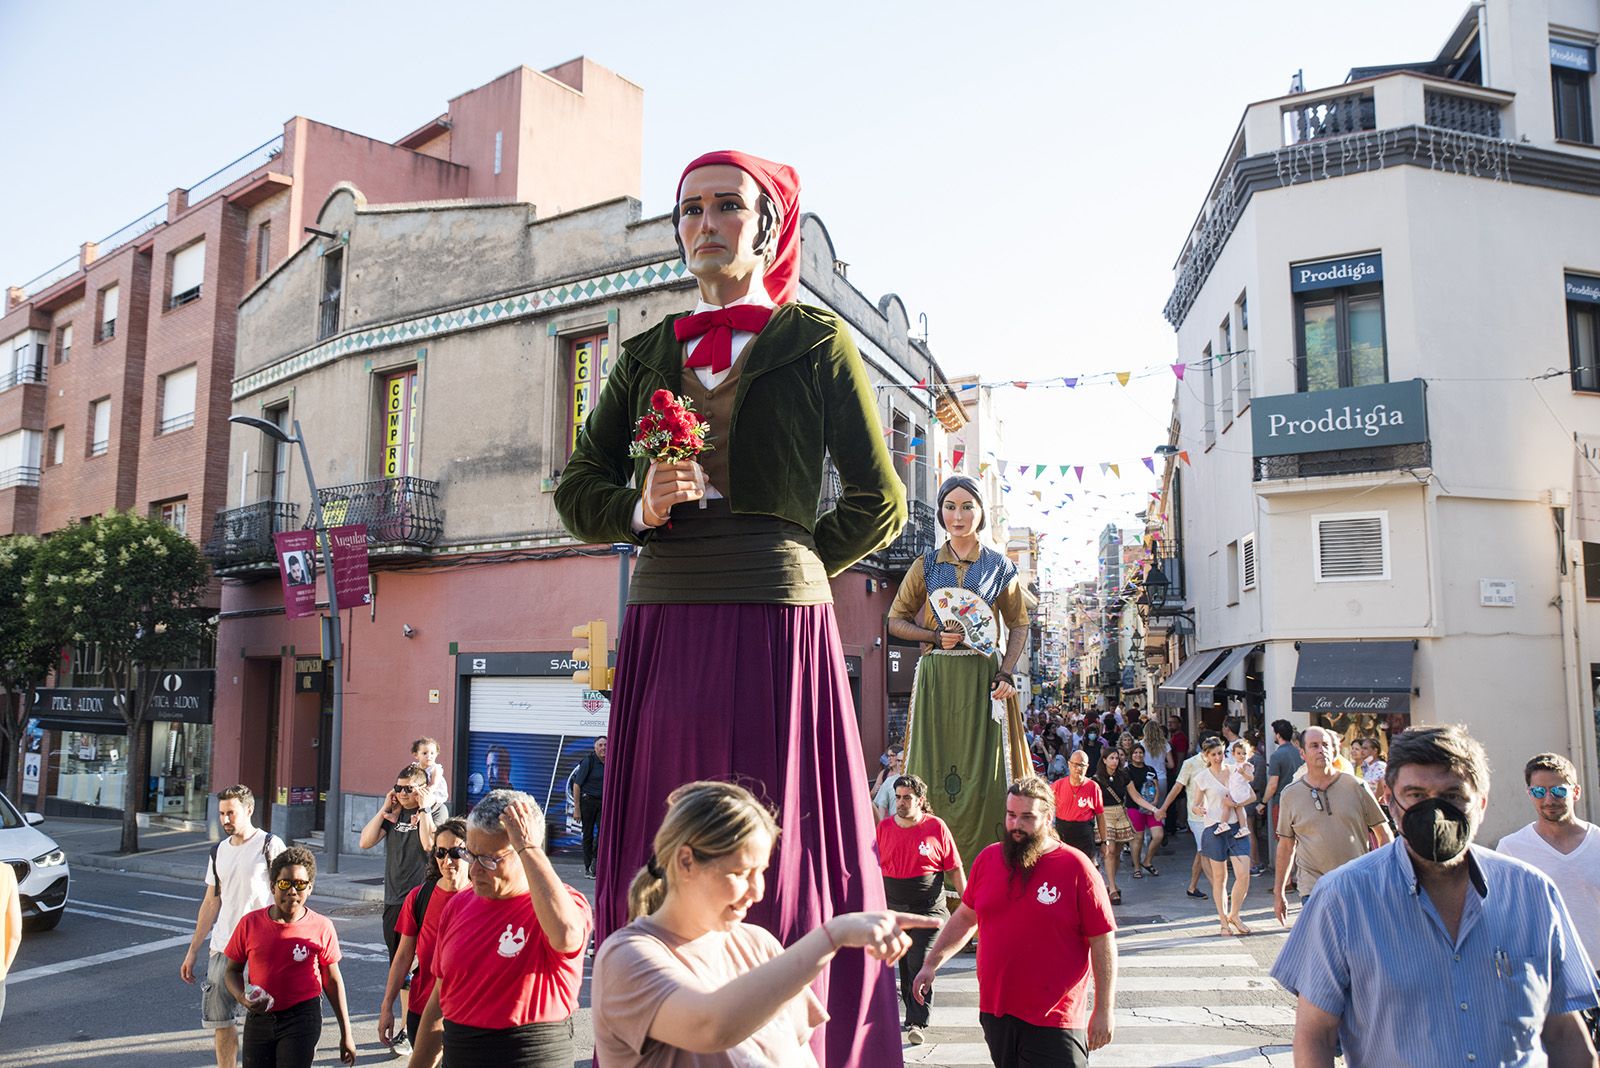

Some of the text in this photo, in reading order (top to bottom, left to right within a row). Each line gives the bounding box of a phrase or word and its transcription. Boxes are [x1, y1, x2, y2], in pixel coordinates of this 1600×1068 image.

[1300, 262, 1376, 284] Proddigia
[388, 384, 401, 474] COMPRO
[1268, 404, 1405, 438] Proddigia
[335, 531, 367, 550] Angular
[550, 659, 590, 670] SARD
[585, 692, 603, 700] TAG
[1311, 696, 1333, 710] Las
